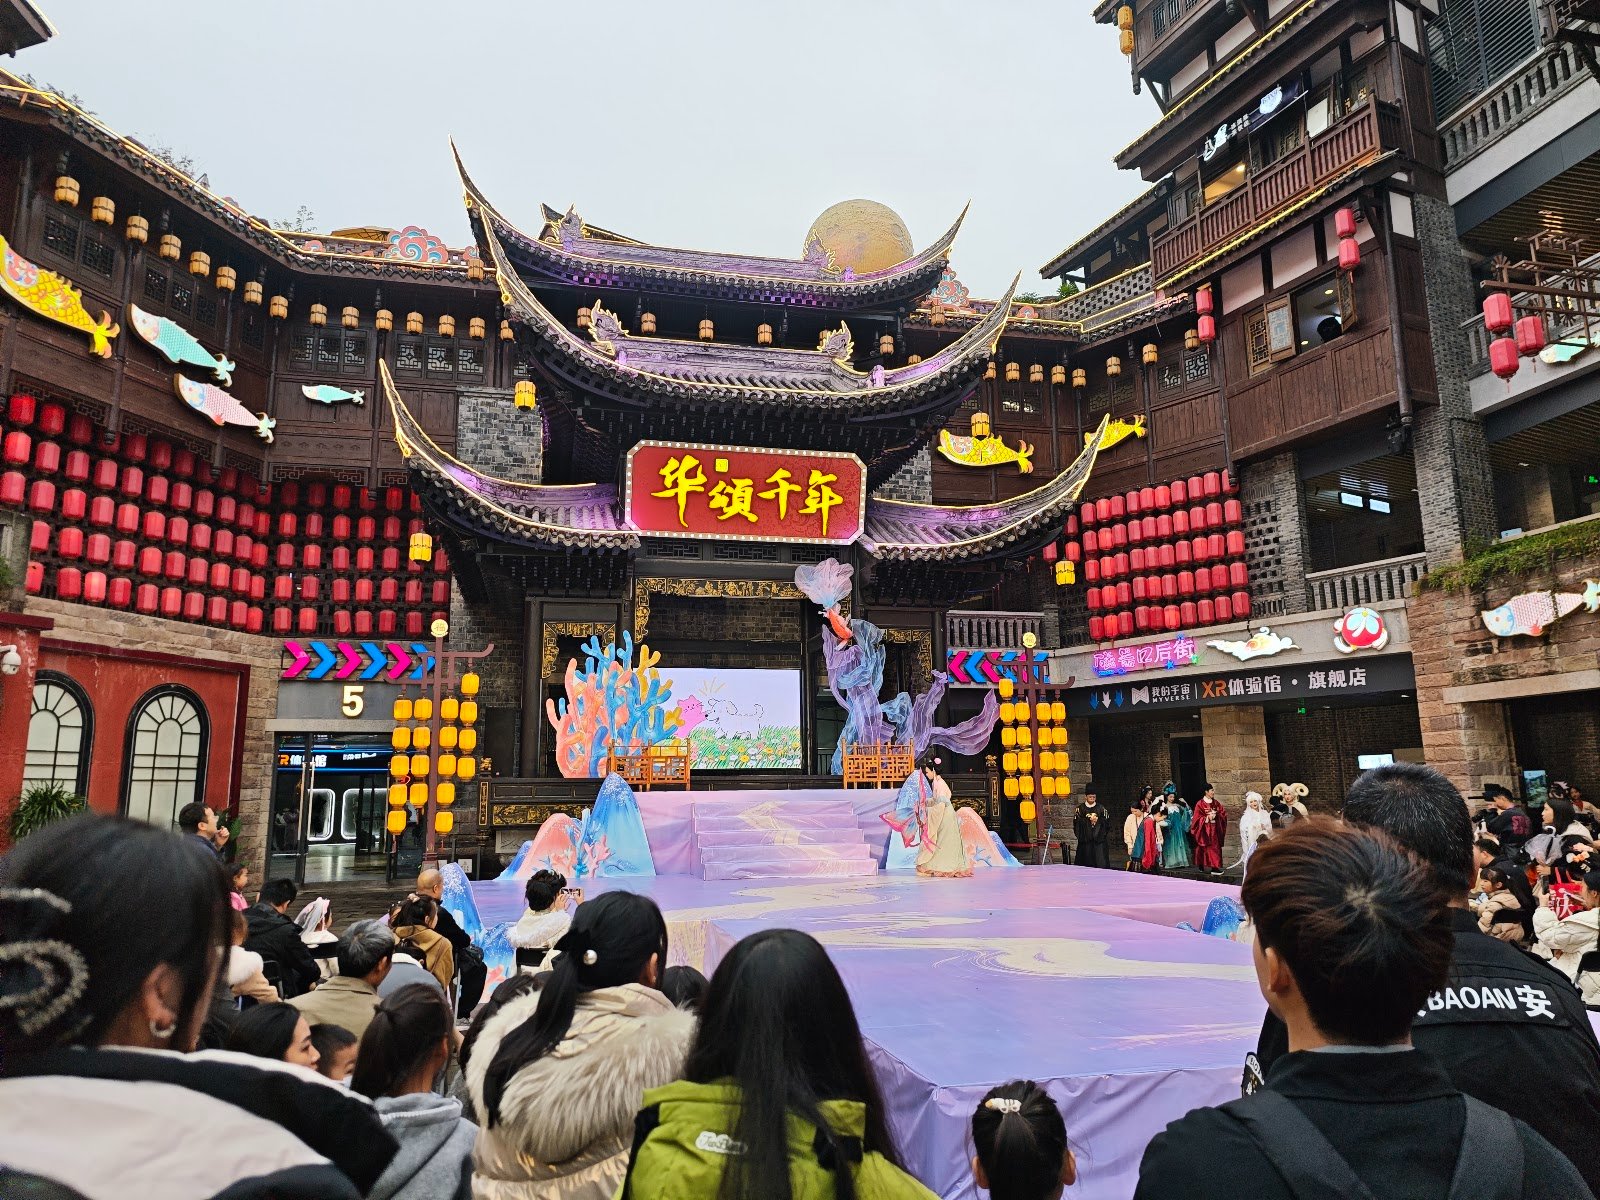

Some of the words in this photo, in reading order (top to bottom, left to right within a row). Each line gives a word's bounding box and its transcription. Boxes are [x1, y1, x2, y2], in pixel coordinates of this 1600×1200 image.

[1151, 683, 1191, 698] 我的宇宙
[1152, 694, 1191, 704] MYVERSE
[1201, 675, 1282, 699] XR体验馆
[1307, 667, 1367, 690] 旗舰店
[342, 685, 365, 718] 5
[1514, 984, 1556, 1020] 安
